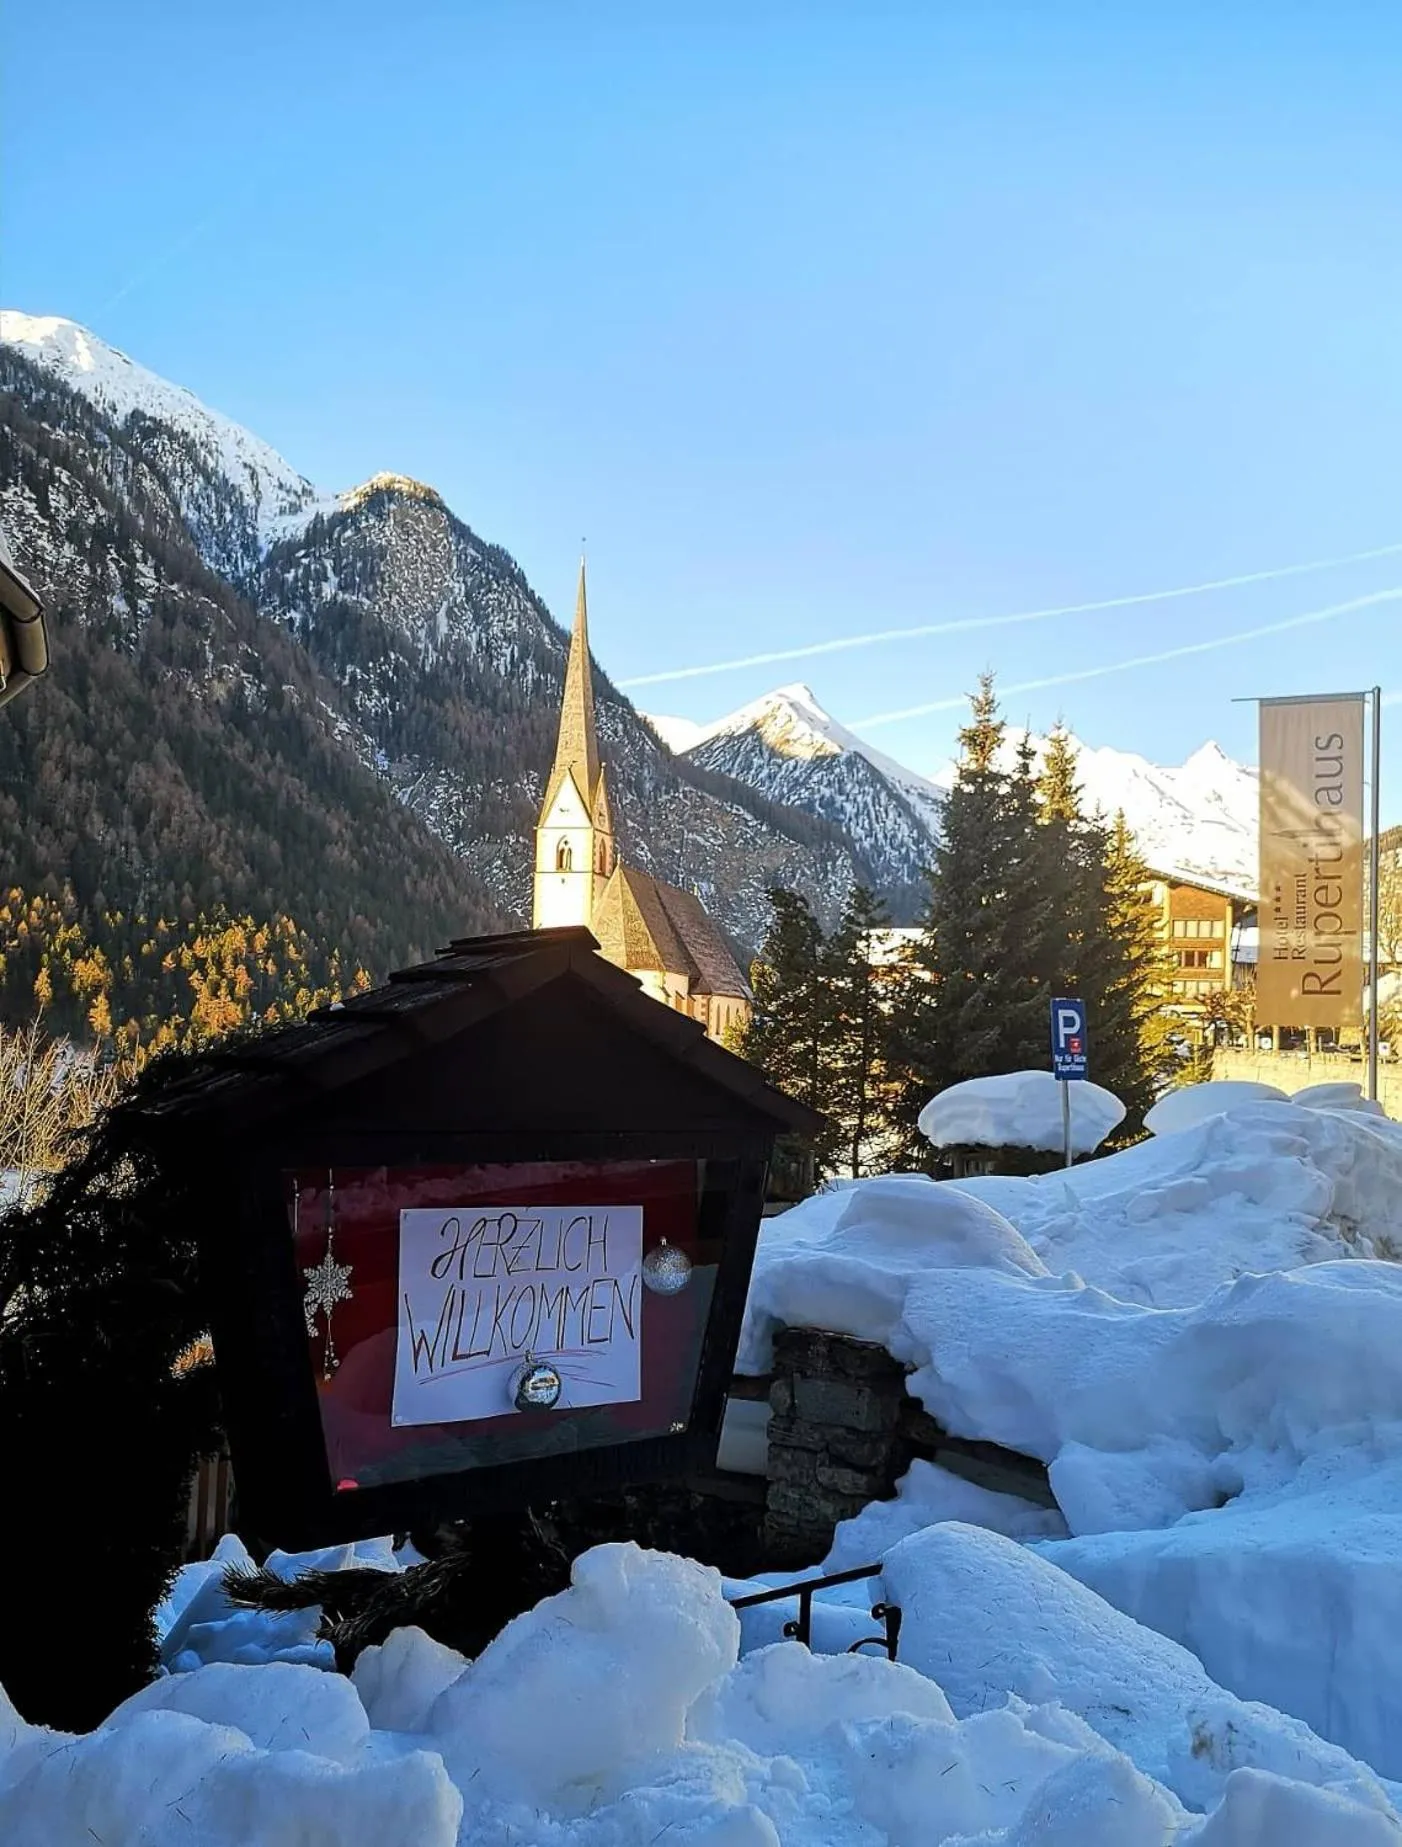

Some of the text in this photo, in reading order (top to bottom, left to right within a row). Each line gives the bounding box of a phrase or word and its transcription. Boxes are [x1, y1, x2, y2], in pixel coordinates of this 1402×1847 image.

[1302, 732, 1357, 996] Rupertihaus
[1273, 916, 1289, 960] Hotel
[1291, 873, 1307, 960] Restaurant
[1058, 1009, 1081, 1048] P
[430, 1212, 608, 1280] HERZLICH
[404, 1275, 637, 1375] WILLKOMMEN
